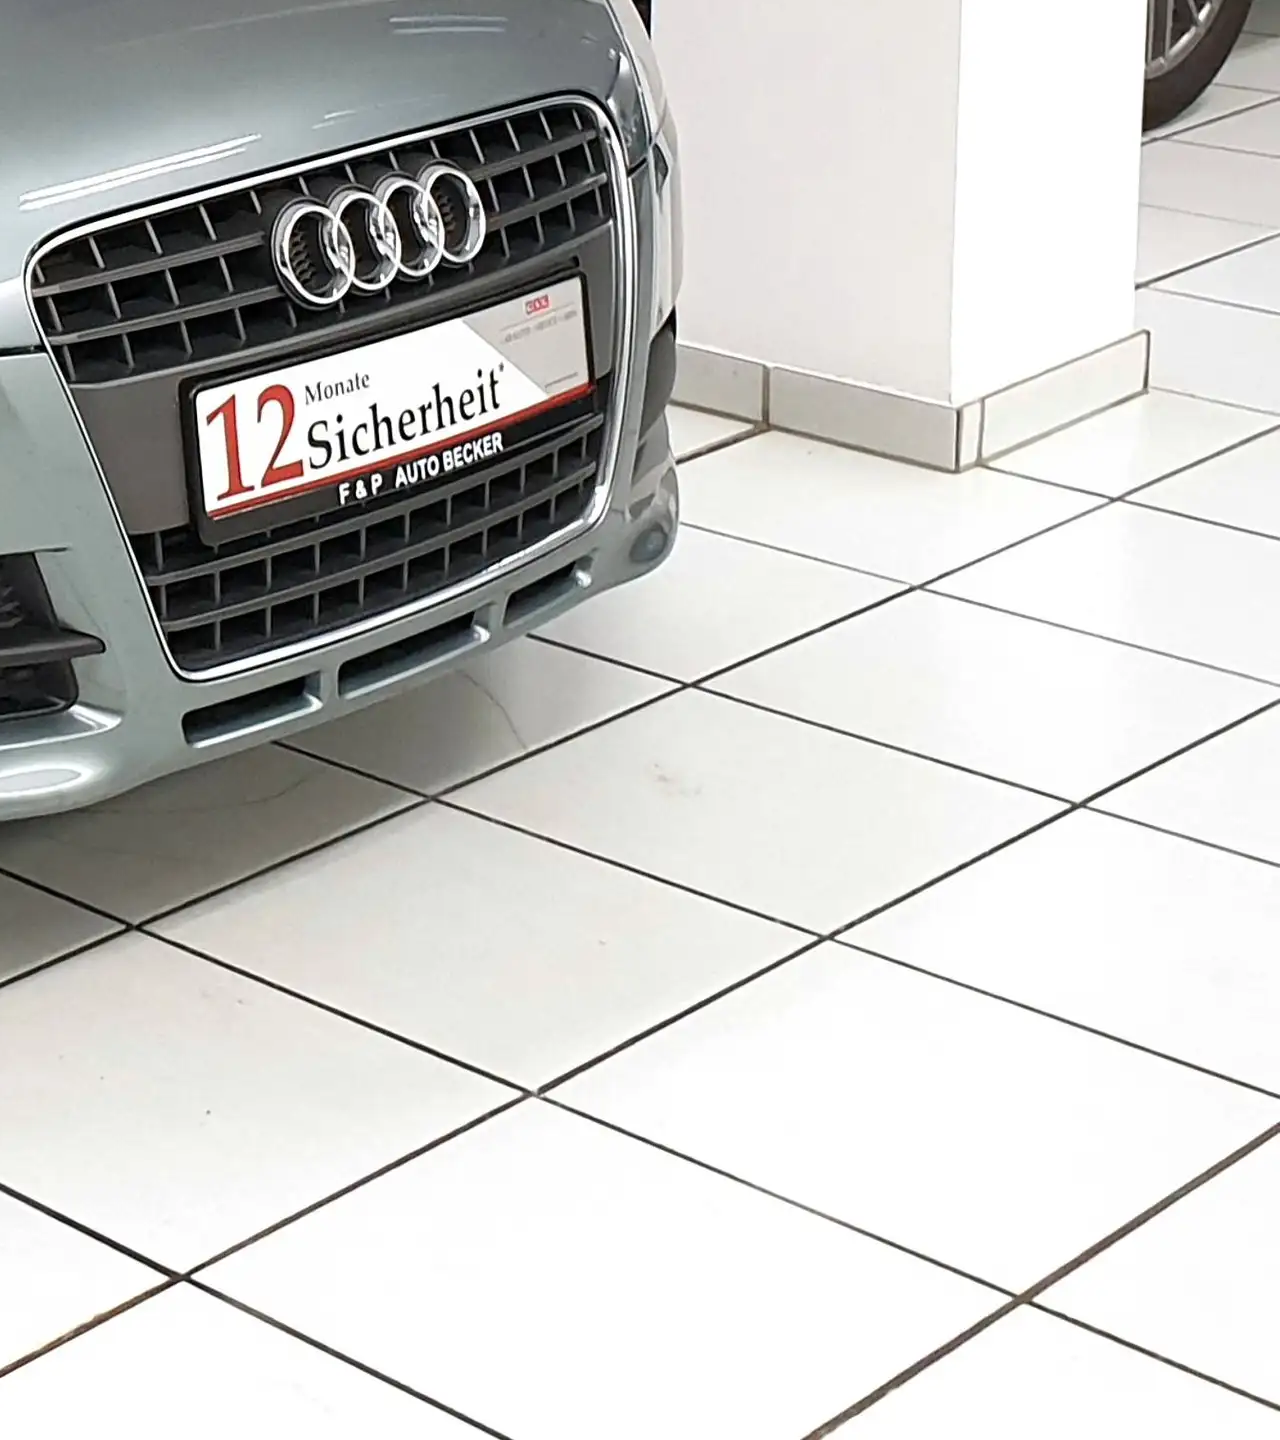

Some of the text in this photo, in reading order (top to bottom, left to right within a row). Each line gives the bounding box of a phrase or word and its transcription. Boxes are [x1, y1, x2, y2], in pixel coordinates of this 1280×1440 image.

[304, 372, 370, 406] Monate
[206, 384, 305, 501] 12
[395, 455, 440, 488] AUTO
[442, 432, 503, 472] BECKER
